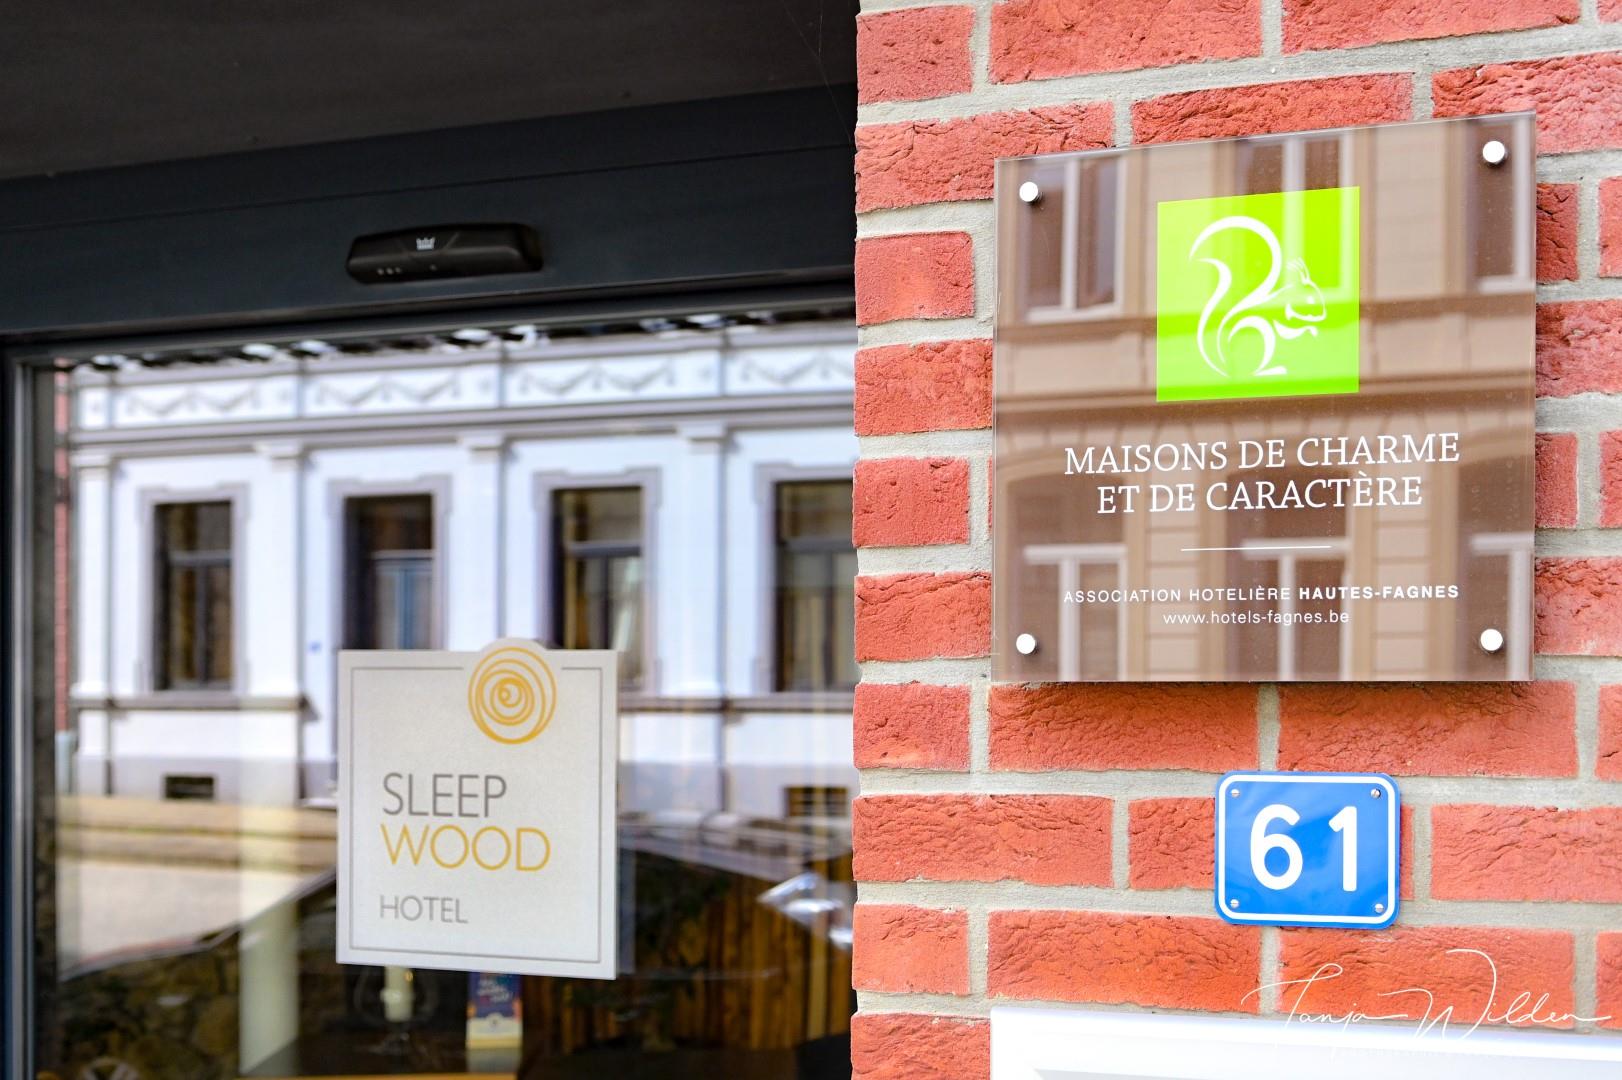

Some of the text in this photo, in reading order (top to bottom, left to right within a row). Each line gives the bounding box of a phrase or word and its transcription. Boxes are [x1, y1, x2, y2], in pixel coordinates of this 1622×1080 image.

[1065, 432, 1461, 475] MAISONS DE CHARME
[1097, 471, 1422, 514] ET DE CARACTÈRE
[1063, 585, 1460, 604] ASSOCIATION HOTELIÈRE HAUTES-FAGNES
[1162, 610, 1350, 626] www.hotels-fagnes.be
[383, 773, 507, 818] SLEEP
[380, 824, 551, 872] WOOD
[1250, 804, 1358, 892] 61
[379, 895, 469, 924] HOTEL
